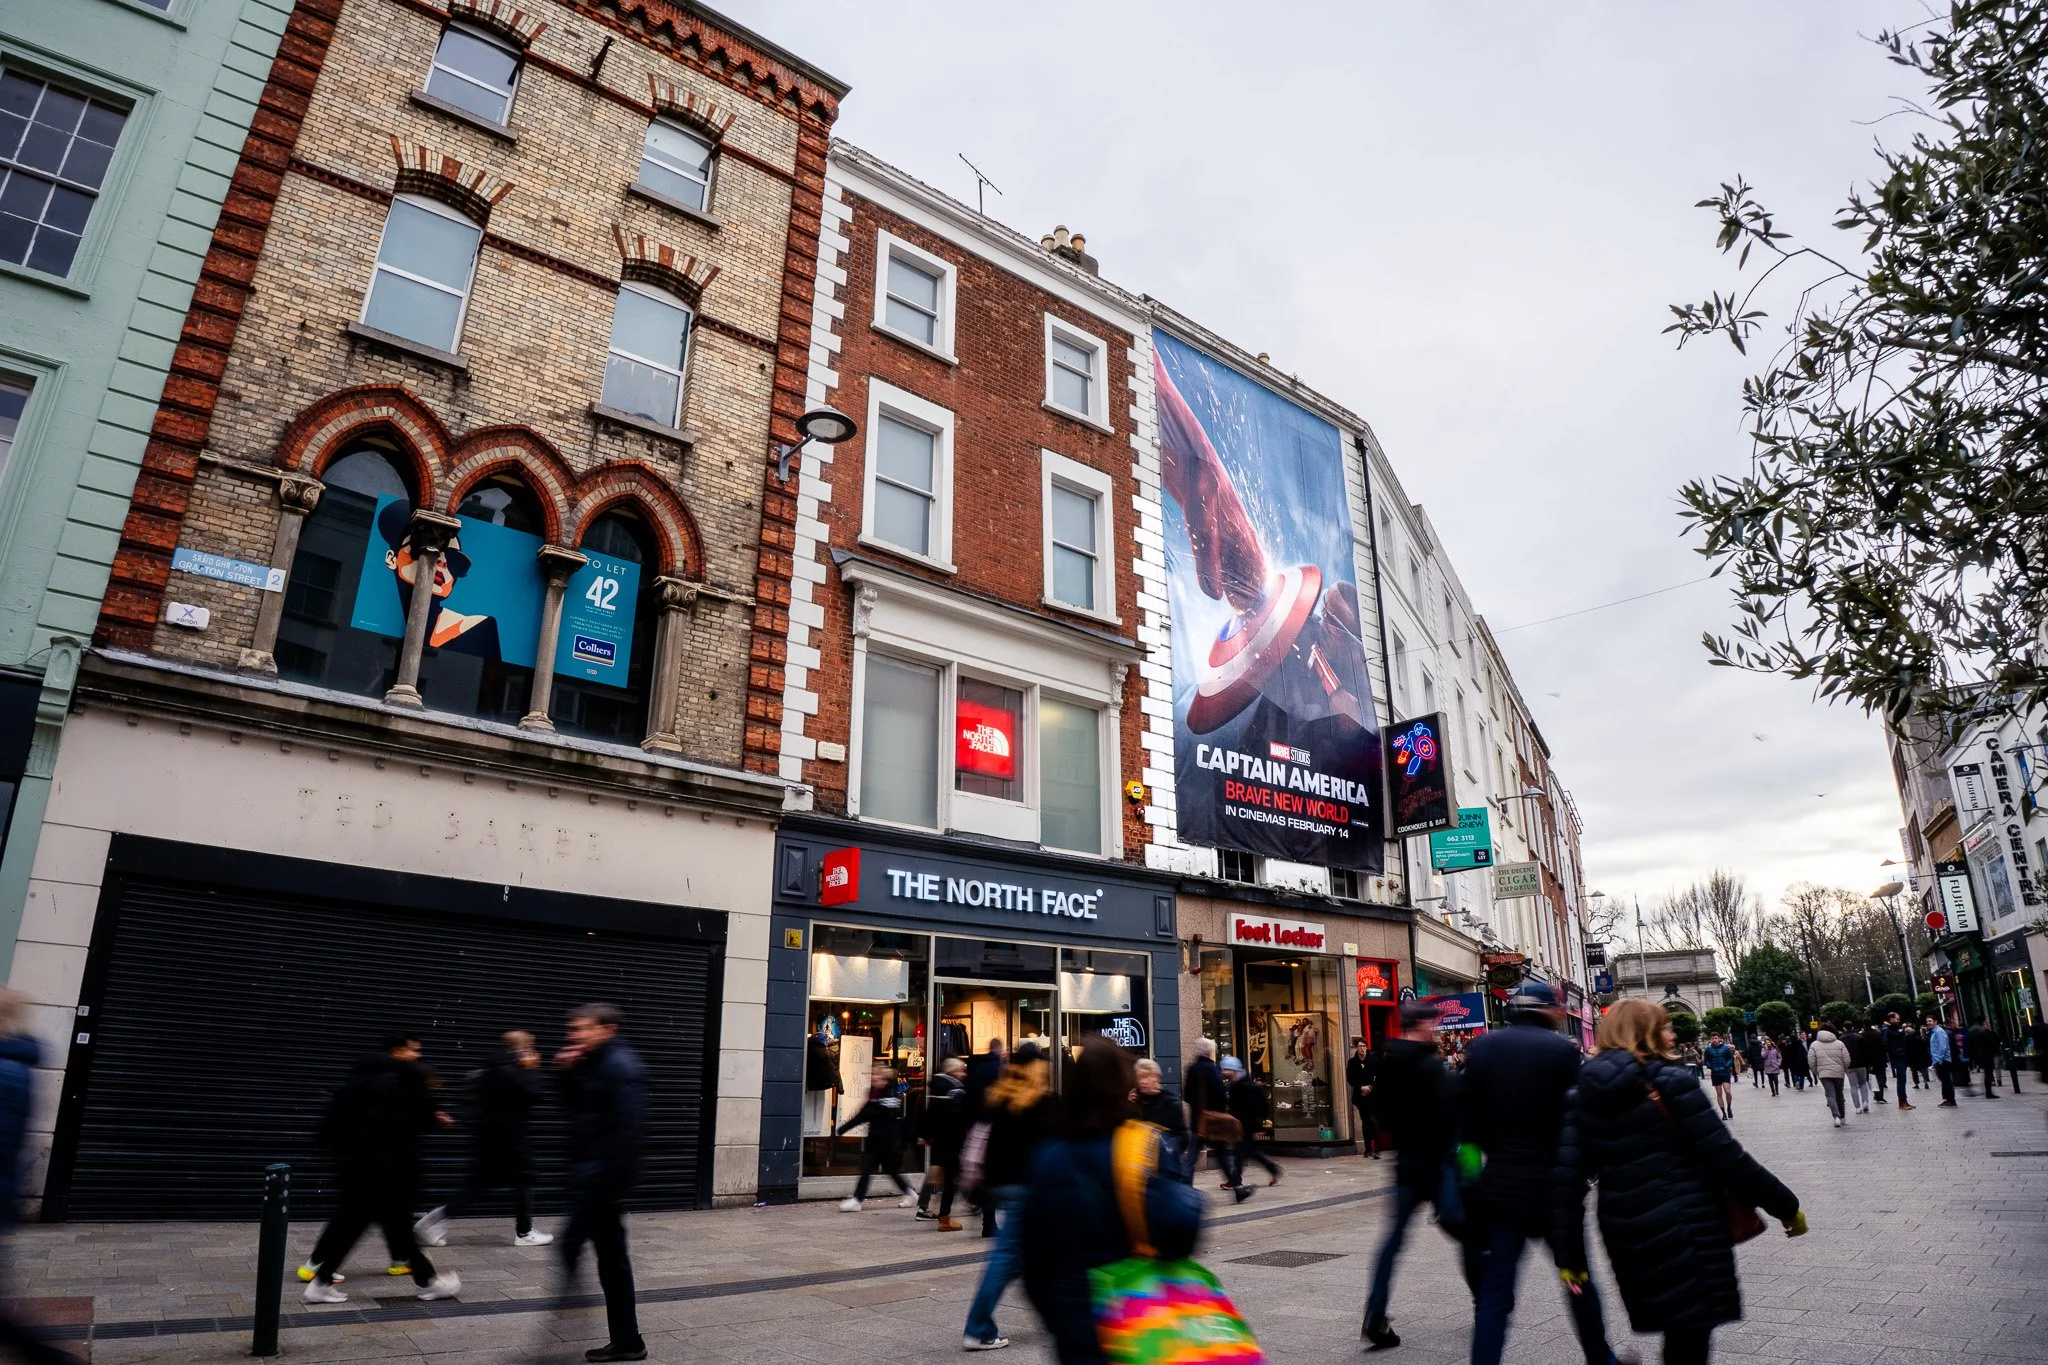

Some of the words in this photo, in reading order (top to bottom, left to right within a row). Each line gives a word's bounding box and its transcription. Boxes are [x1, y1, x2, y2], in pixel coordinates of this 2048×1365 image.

[606, 563, 627, 576] LET
[226, 571, 263, 585] STREET
[270, 574, 281, 586] 2
[585, 575, 619, 611] 42
[578, 640, 612, 656] Colliers
[963, 729, 993, 744] NORTH
[976, 724, 993, 735] THE
[971, 740, 993, 753] FACE
[1291, 748, 1311, 765] STUDIOS
[1196, 743, 1286, 787] CAPTAIN
[1288, 766, 1369, 807] AMERICA
[1965, 777, 1979, 809] FUJIFILM
[1225, 780, 1271, 808] BRAVE
[1273, 791, 1303, 814] NEW
[1306, 798, 1349, 823] WORLD
[1225, 804, 1237, 817] IN
[1238, 808, 1286, 827] CINEMAS
[1287, 818, 1336, 836] FEBRUARY
[1337, 827, 1349, 839] 14
[1397, 821, 1428, 833] COOKHOUSE
[1435, 818, 1446, 826] BAR
[1458, 821, 1484, 829] GNEW
[1986, 738, 2017, 817] CAMERA
[2007, 824, 2037, 906] CENTRE
[1511, 867, 1535, 875] DECENT
[1498, 873, 1537, 885] CIGAR
[887, 869, 940, 901] THE
[946, 877, 1033, 912] NORTH
[1041, 889, 1098, 920] FACE
[1499, 884, 1537, 892] EMPORIUM
[1950, 879, 1969, 929] FUJIFILM
[1235, 918, 1271, 943] Foot
[1274, 923, 1324, 948] Locker
[1113, 1017, 1130, 1028] THE
[1101, 1027, 1130, 1038] NORTH
